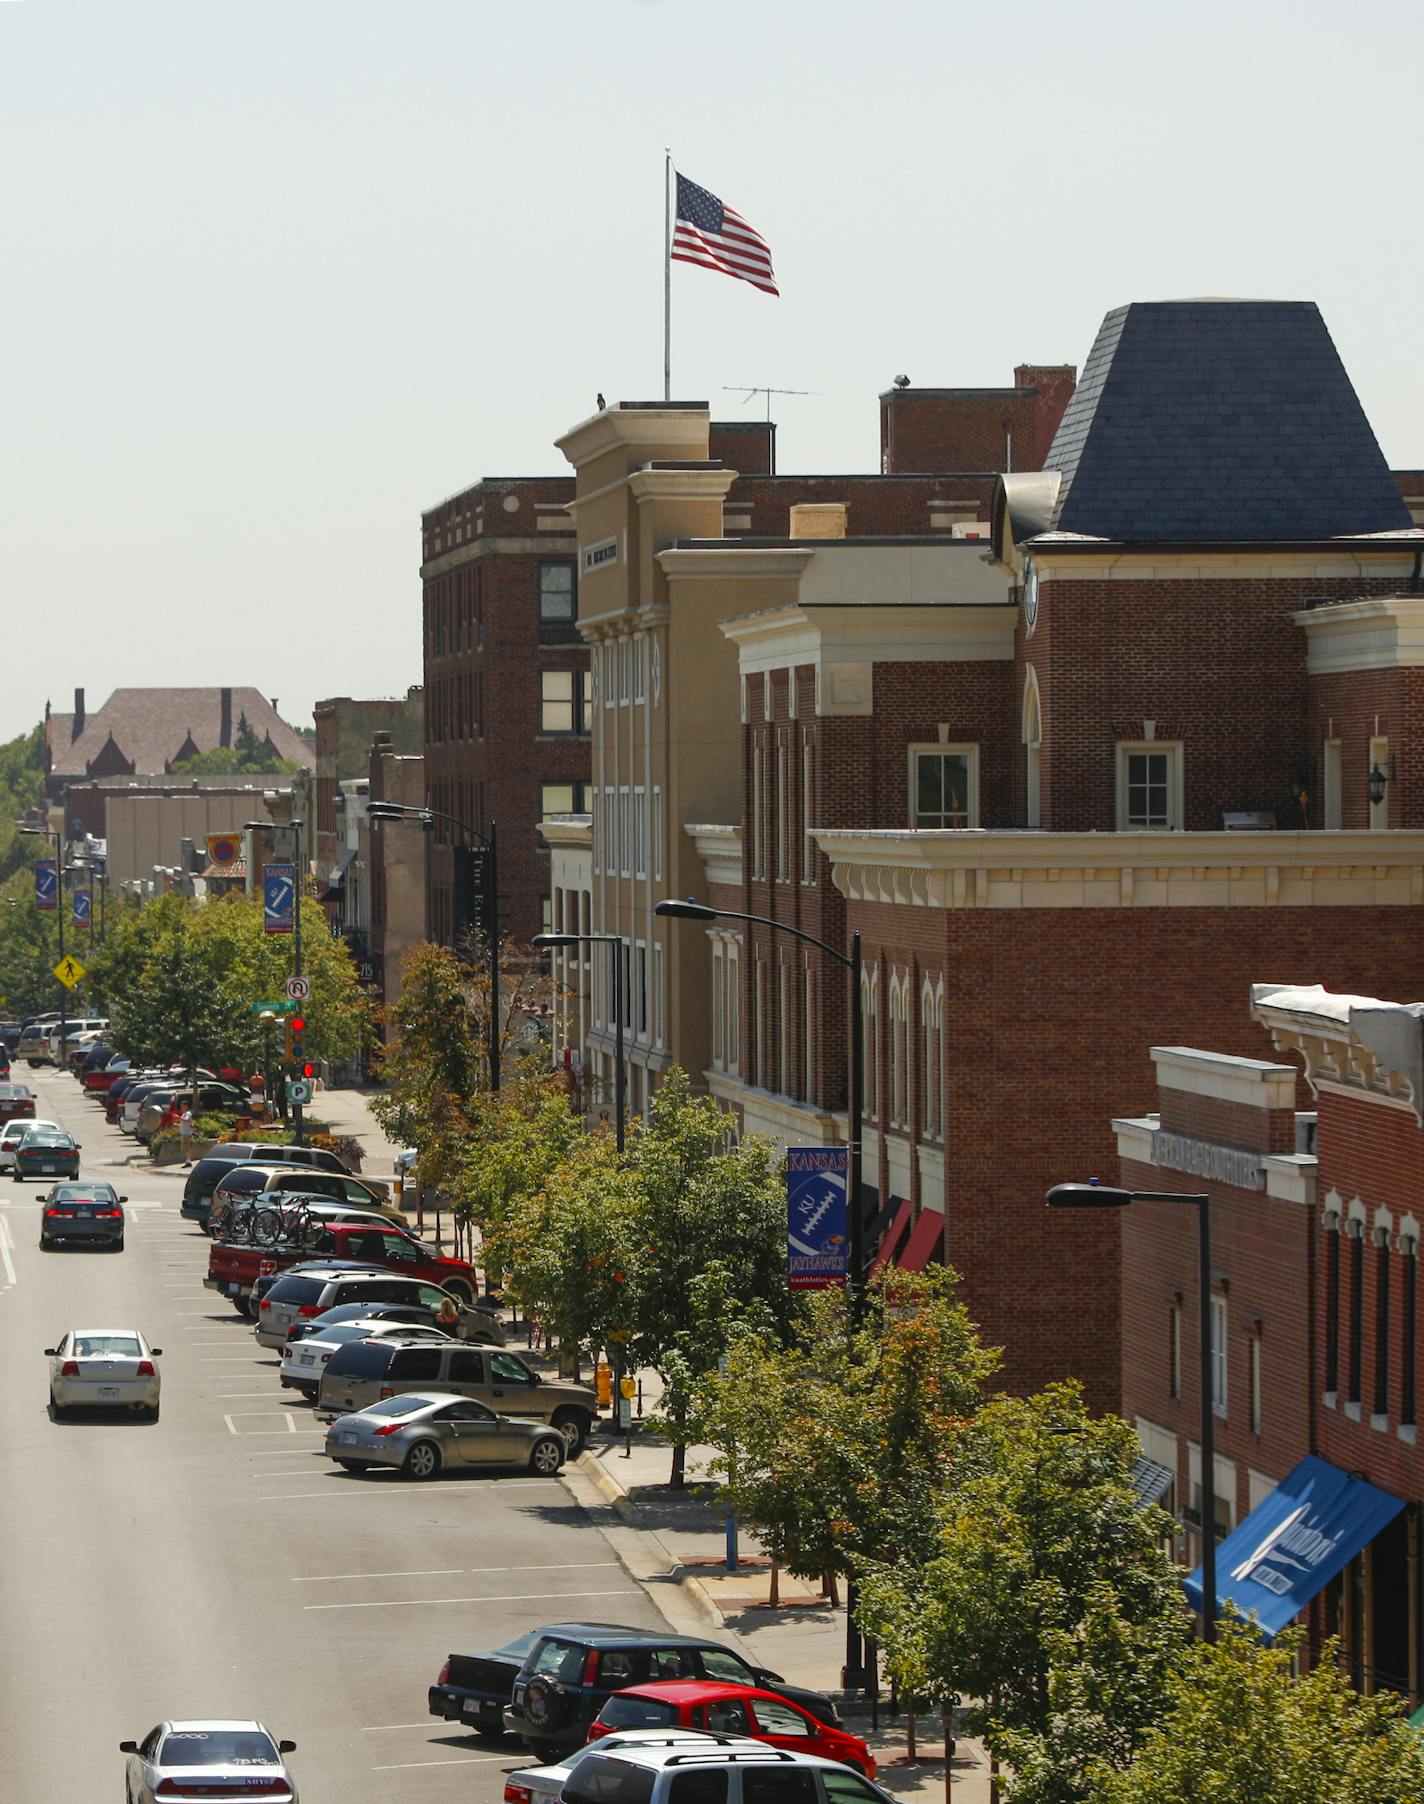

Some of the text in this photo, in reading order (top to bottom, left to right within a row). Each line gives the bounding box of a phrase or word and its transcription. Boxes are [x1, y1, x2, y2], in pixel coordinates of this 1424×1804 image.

[295, 1087, 304, 1097] P
[789, 1153, 846, 1171] KANSAS
[798, 1194, 815, 1214] KU
[789, 1256, 845, 1274] JAYHAWKS
